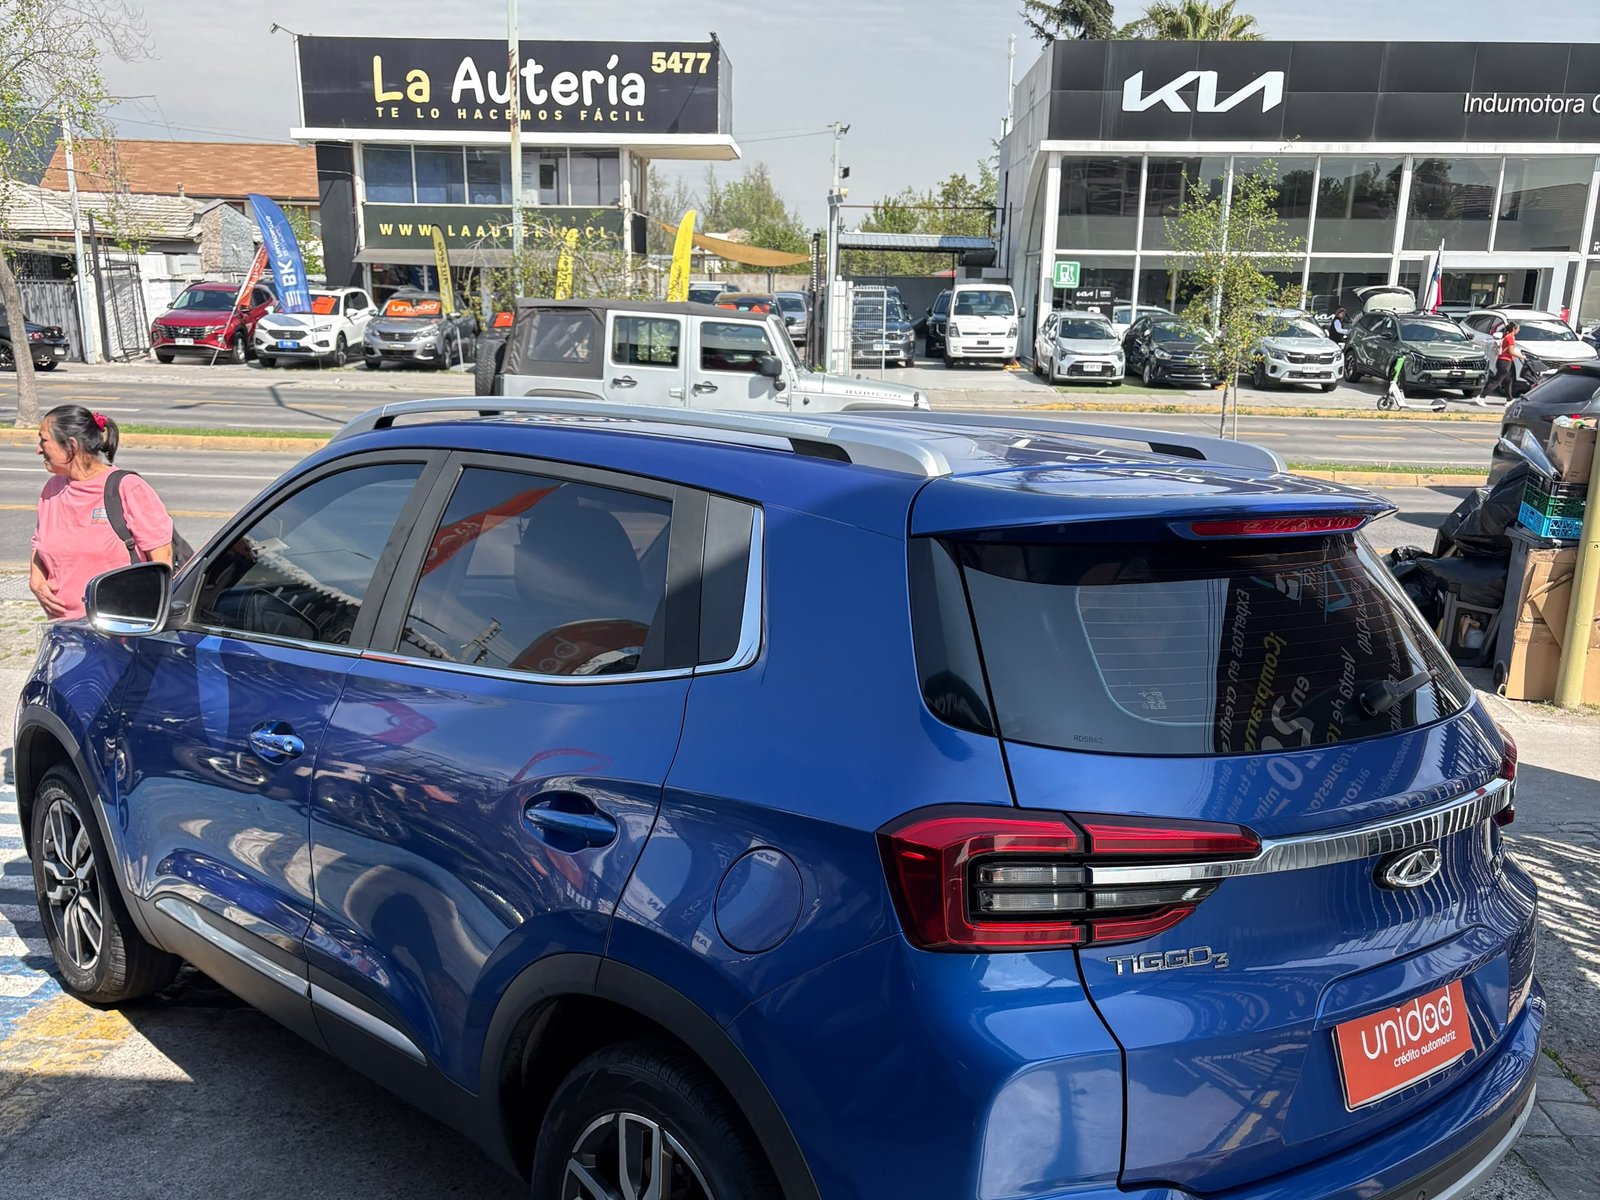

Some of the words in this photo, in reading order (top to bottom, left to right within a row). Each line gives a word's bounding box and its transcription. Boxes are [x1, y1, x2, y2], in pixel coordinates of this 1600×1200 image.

[651, 51, 711, 74] 5477
[373, 55, 430, 103] La
[451, 54, 646, 106] Autería
[1121, 70, 1285, 113] KIA
[376, 107, 399, 118] TE
[416, 108, 440, 118] LO
[457, 108, 563, 120] HACEMOS
[580, 107, 645, 121] FÁCIL
[1463, 92, 1585, 113] Indumotora
[277, 260, 297, 287] BK
[1073, 735, 1103, 744] RDSB62
[1361, 985, 1453, 1060] unidad
[1393, 1049, 1420, 1068] crédito
[1421, 1029, 1456, 1055] automotriz
